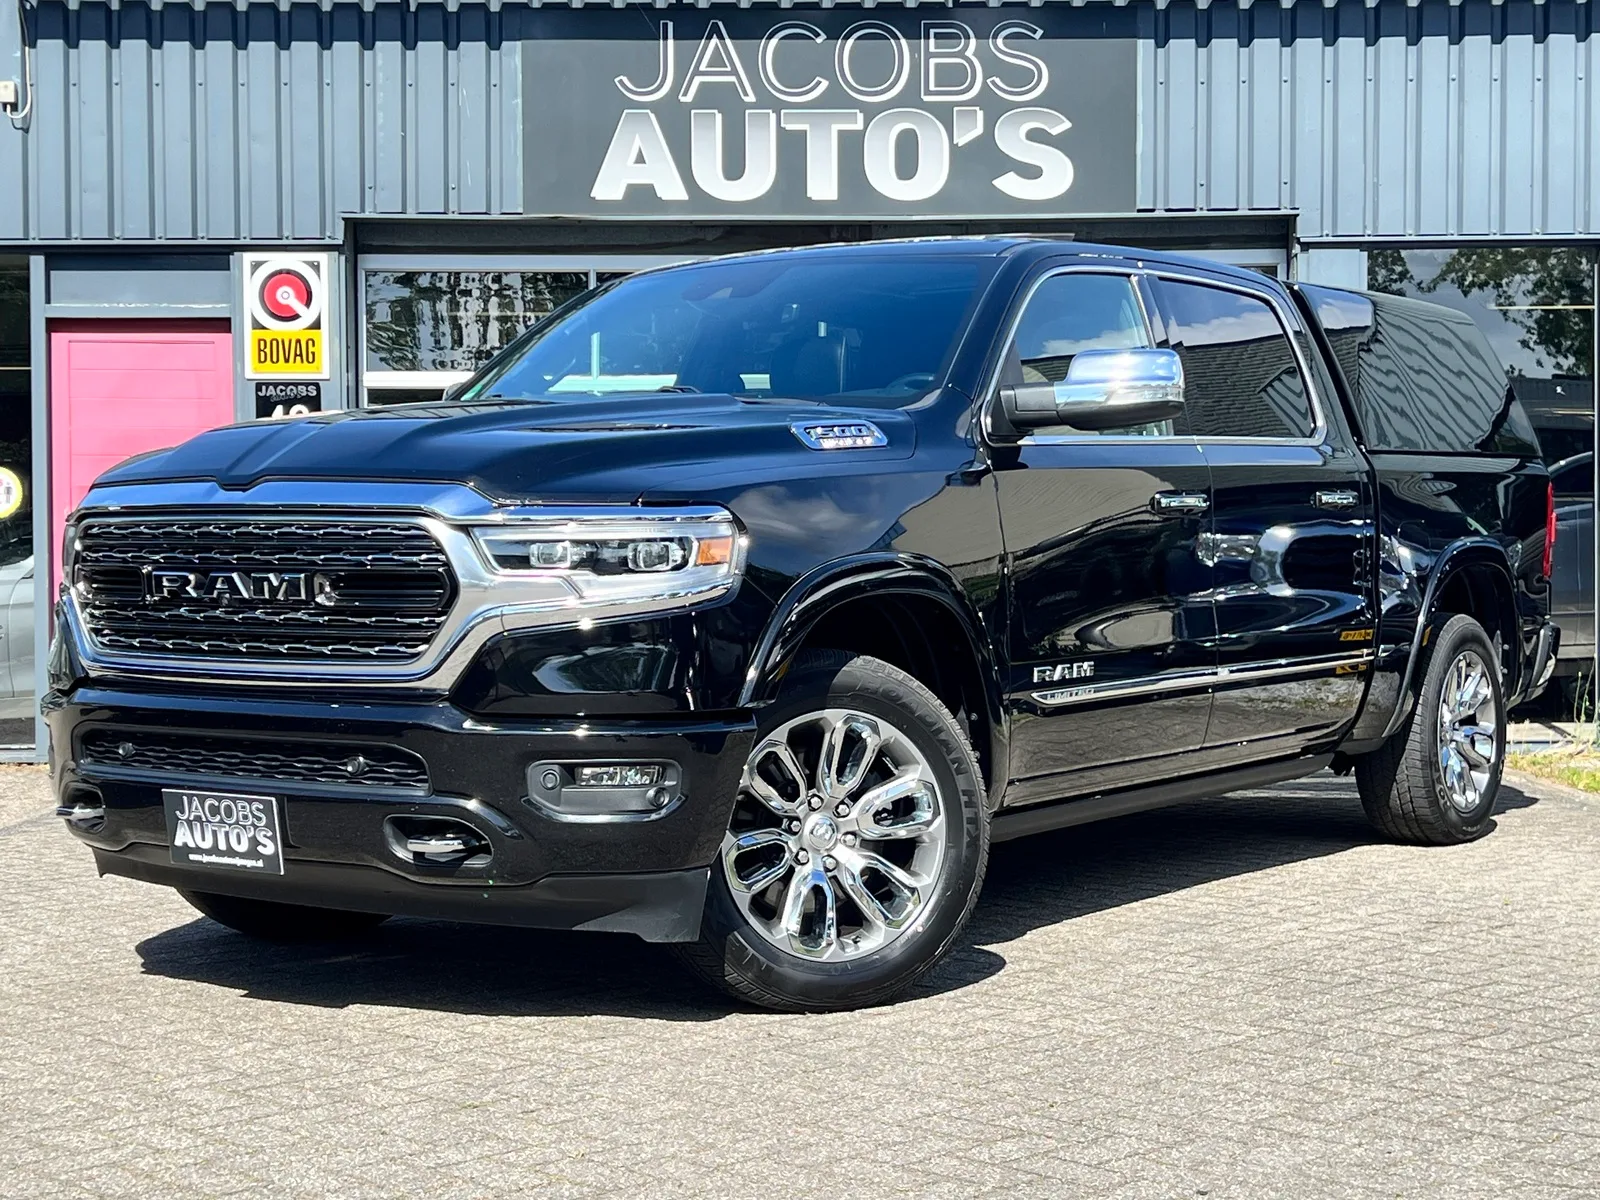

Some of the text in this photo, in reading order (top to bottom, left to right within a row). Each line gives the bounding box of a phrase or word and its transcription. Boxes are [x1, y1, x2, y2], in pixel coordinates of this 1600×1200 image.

[614, 20, 1049, 102] JACOBS
[590, 107, 1075, 201] AUTO'S
[257, 338, 316, 364] BOVAG
[257, 385, 317, 397] JACOBS
[806, 425, 870, 441] 1500
[152, 571, 309, 599] RAM
[1033, 661, 1095, 683] RAM
[175, 795, 267, 826] JACOBS
[174, 820, 275, 855] AUTO'S
